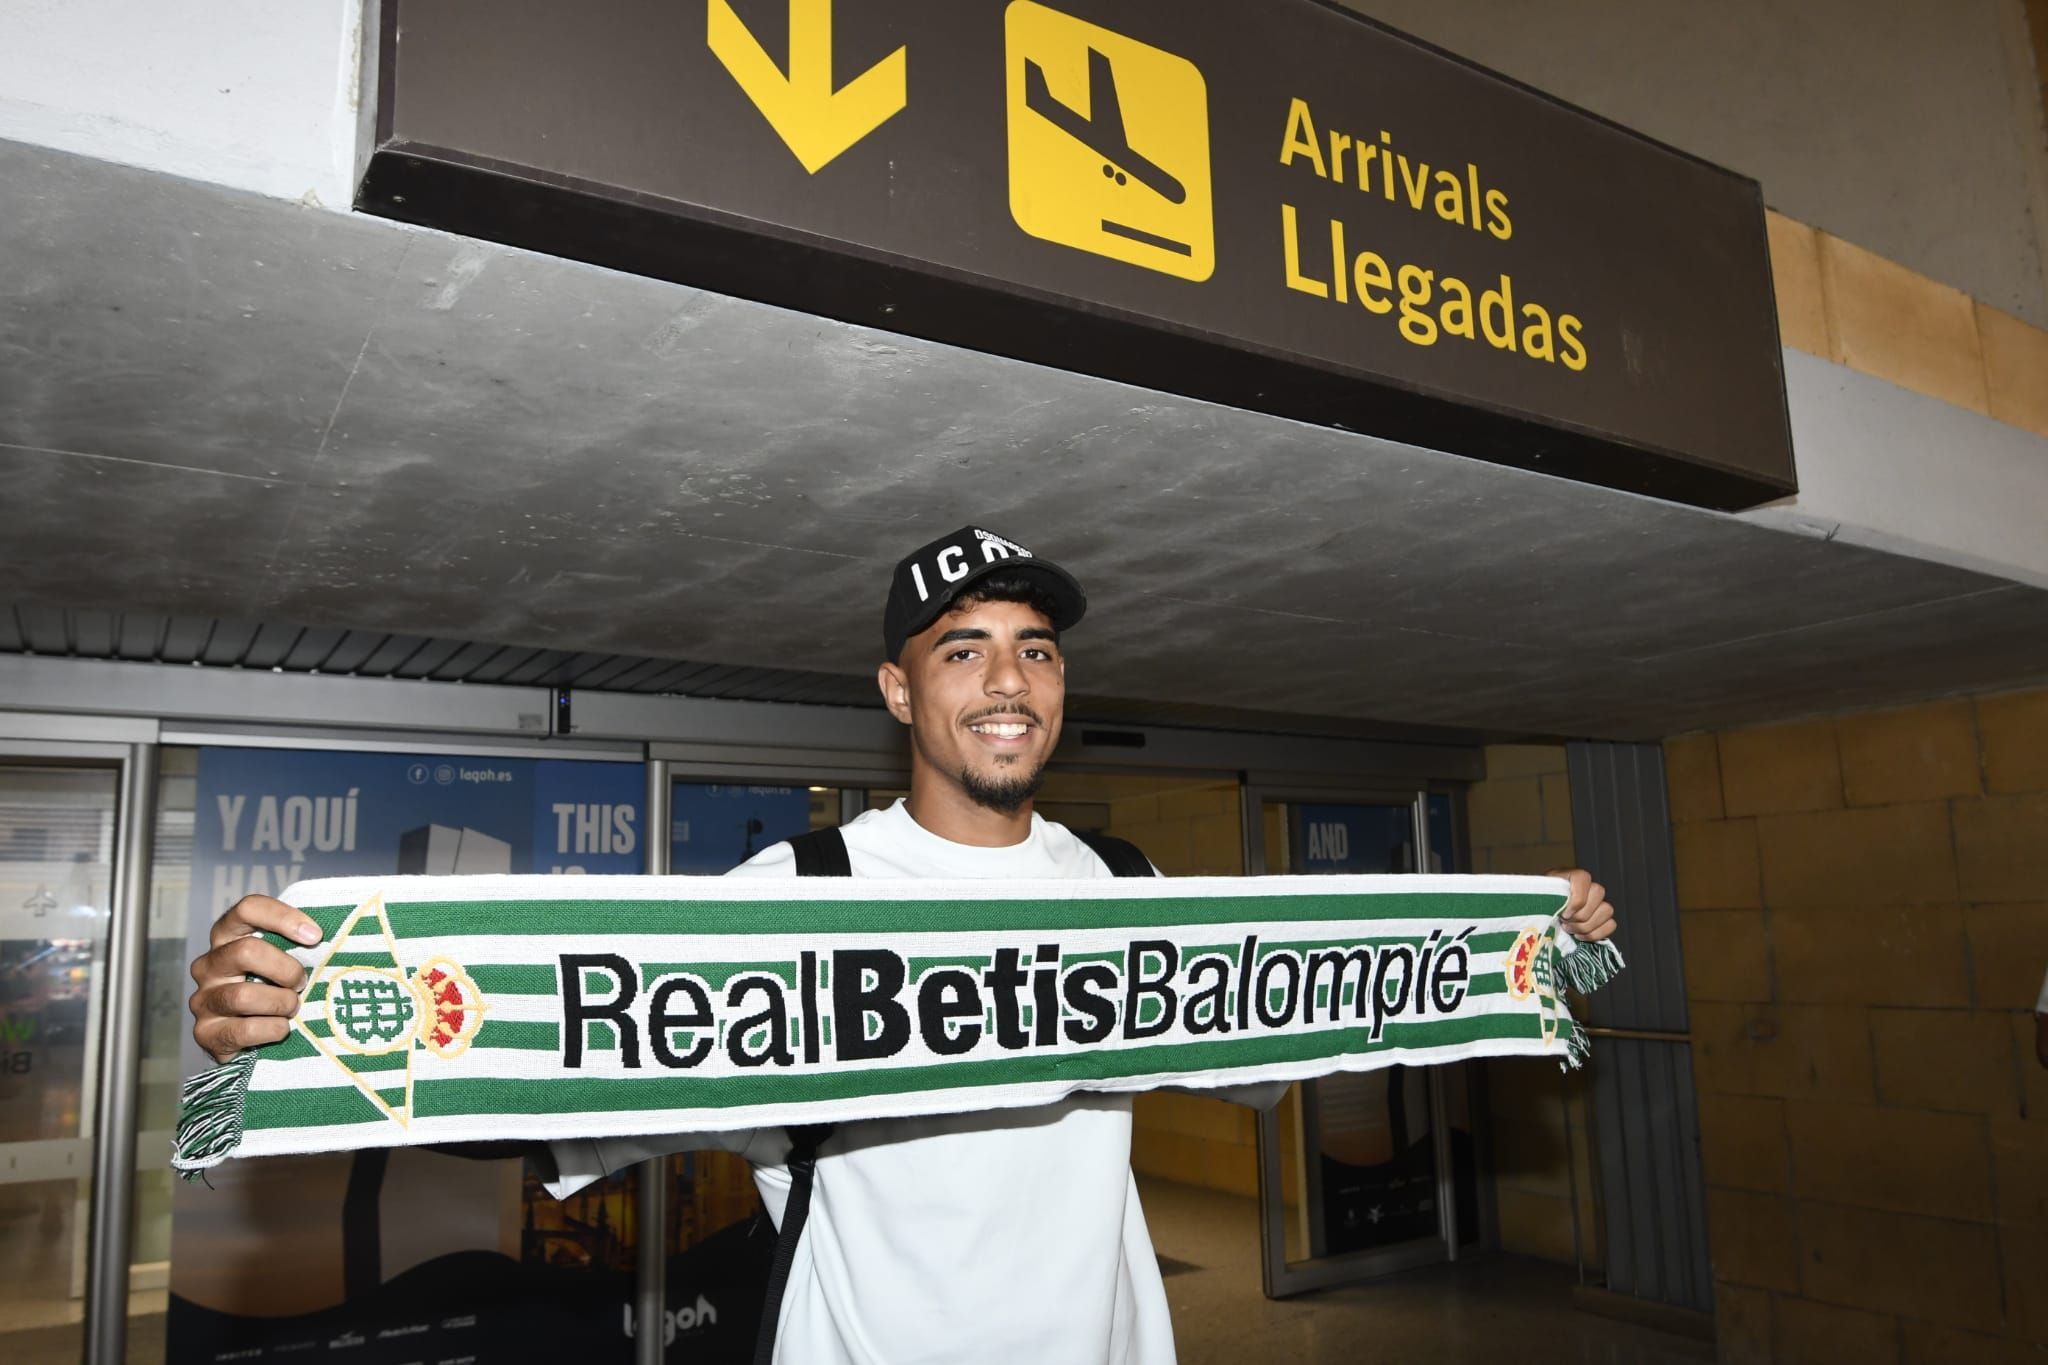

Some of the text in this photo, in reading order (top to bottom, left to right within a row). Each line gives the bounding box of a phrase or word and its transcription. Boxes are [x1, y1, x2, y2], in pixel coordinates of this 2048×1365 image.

[1279, 97, 1512, 240] Arrivals
[1281, 203, 1588, 371] Llegadas
[216, 787, 360, 862] Y AQUÍ
[552, 803, 636, 855] THIS
[1308, 822, 1348, 860] AND
[623, 1294, 717, 1347] lgoh
